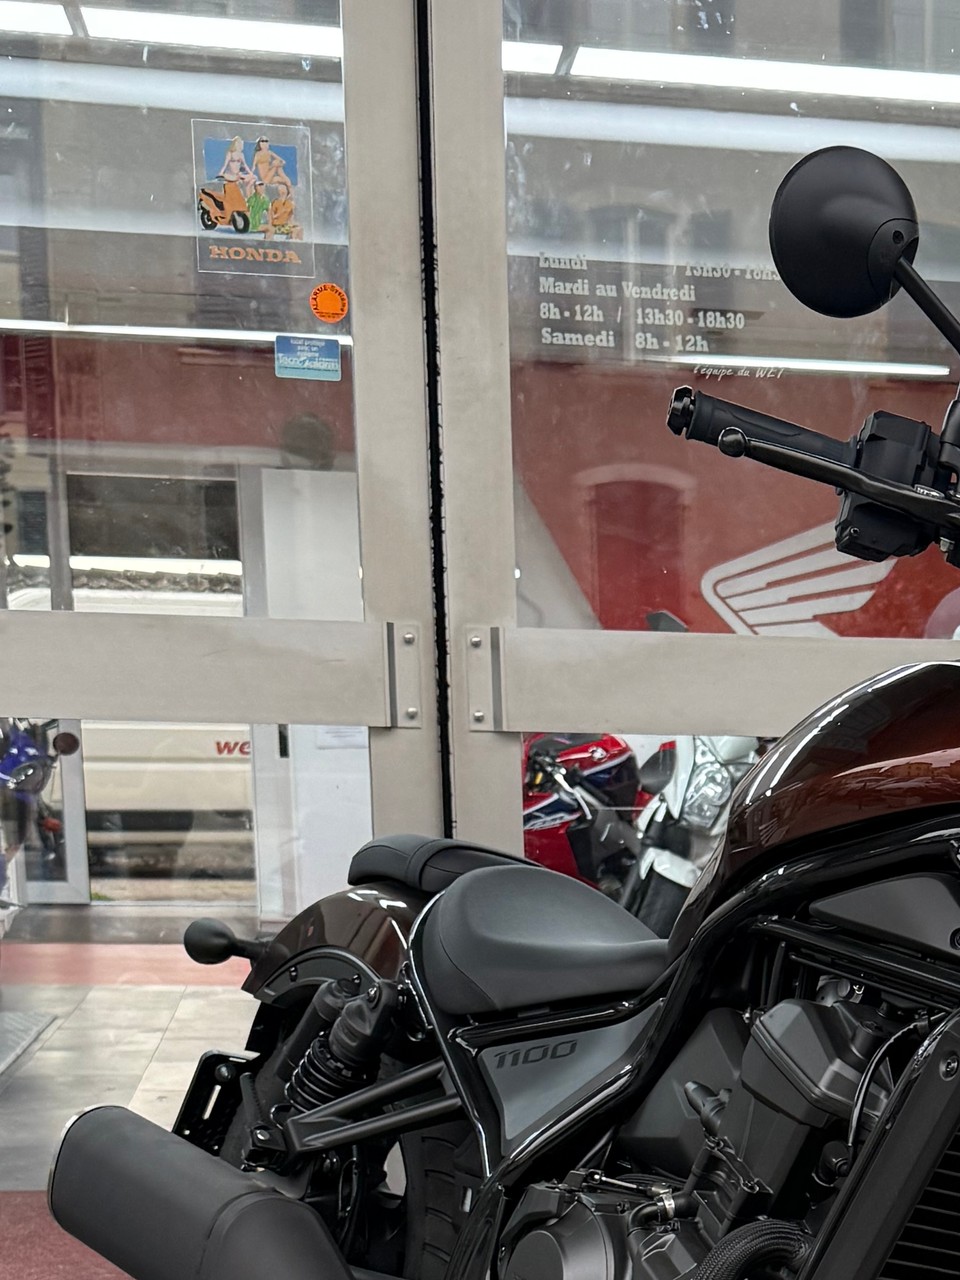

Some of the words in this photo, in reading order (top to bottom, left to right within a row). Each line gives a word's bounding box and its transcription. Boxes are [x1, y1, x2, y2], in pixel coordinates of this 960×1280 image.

[208, 244, 302, 264] HONDA
[539, 251, 588, 270] Lundi
[744, 266, 781, 281] 18h3
[539, 276, 589, 296] Mardi
[595, 284, 617, 297] au
[621, 281, 696, 301] Vendredi
[540, 302, 561, 319] 8h
[574, 304, 604, 322] 12h
[636, 307, 684, 326] 13h30
[697, 310, 745, 329] 18h30
[541, 327, 615, 347] Samedi
[635, 332, 659, 349] 8h
[675, 334, 709, 352] 12h
[493, 1039, 578, 1069] 1100
